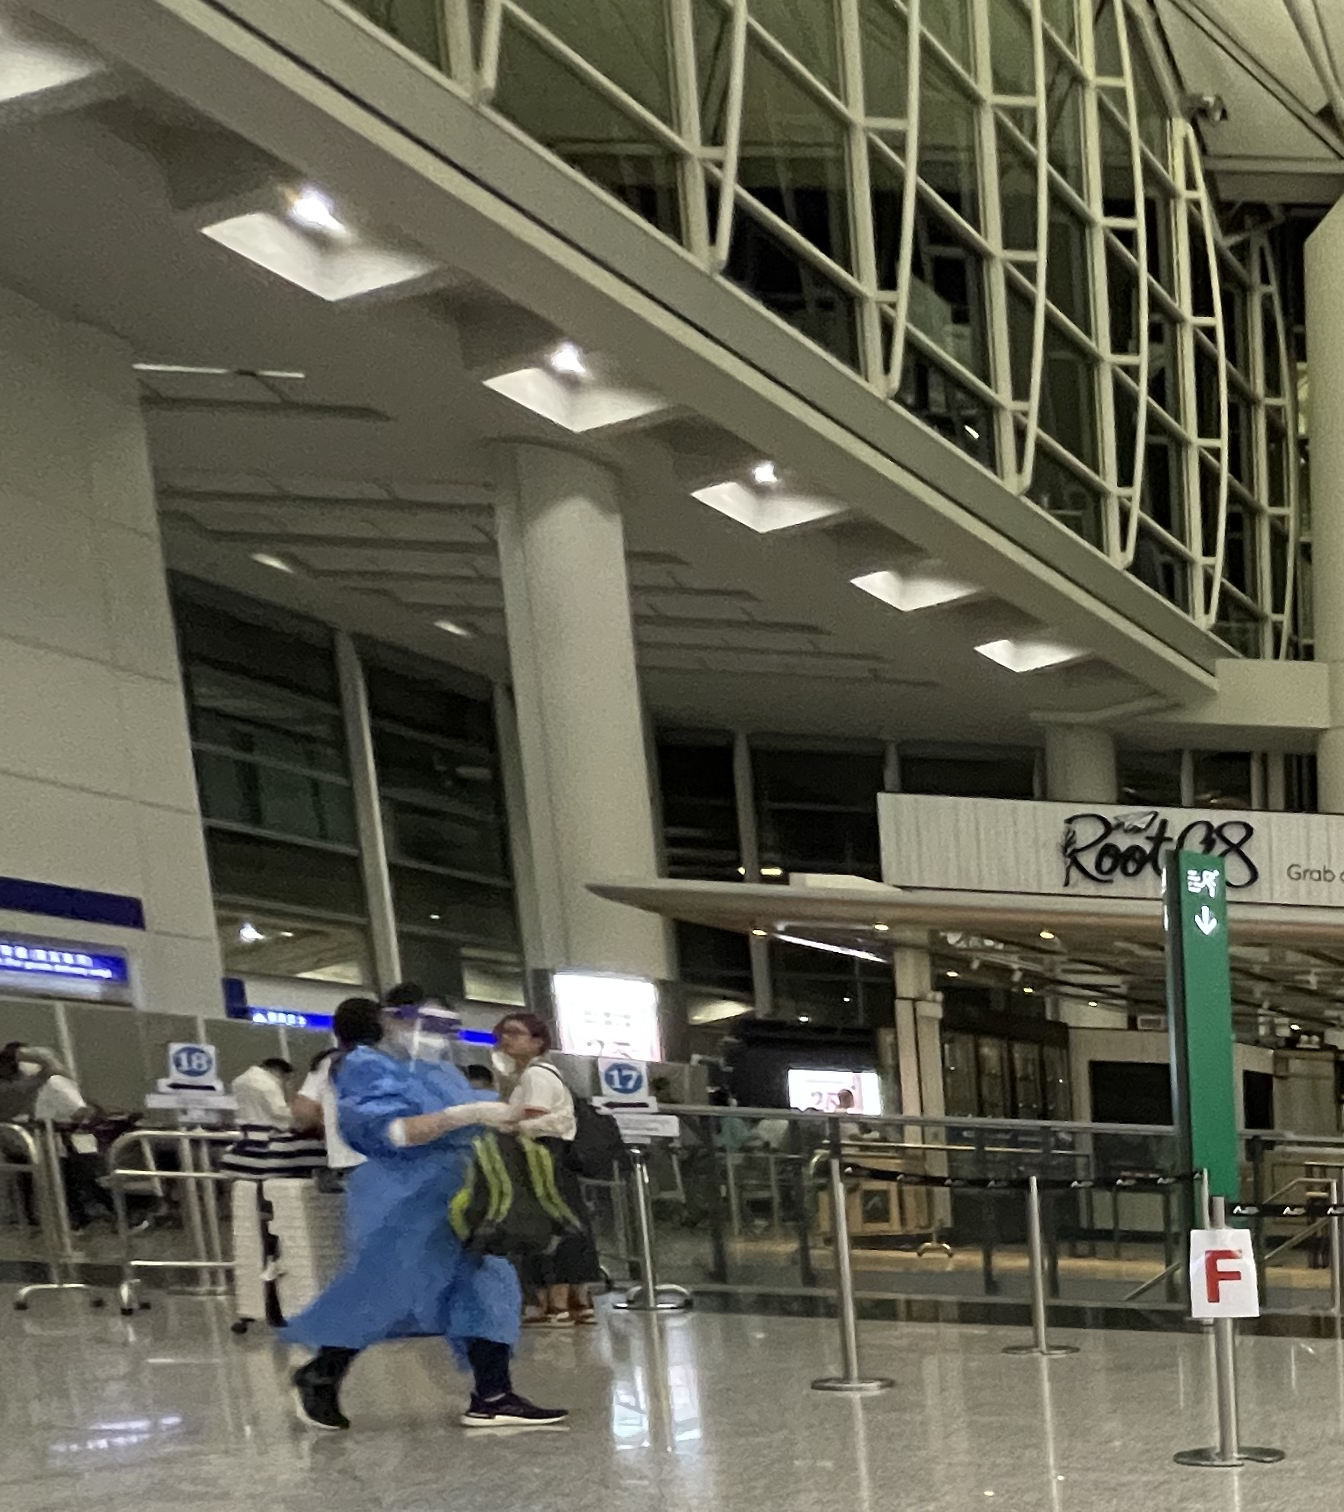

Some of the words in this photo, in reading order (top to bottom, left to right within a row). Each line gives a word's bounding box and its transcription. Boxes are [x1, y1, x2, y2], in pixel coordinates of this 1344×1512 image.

[1287, 863, 1336, 884] Grab
[179, 1051, 208, 1072] 18
[608, 1069, 639, 1090] 17
[1204, 1249, 1243, 1304] F
